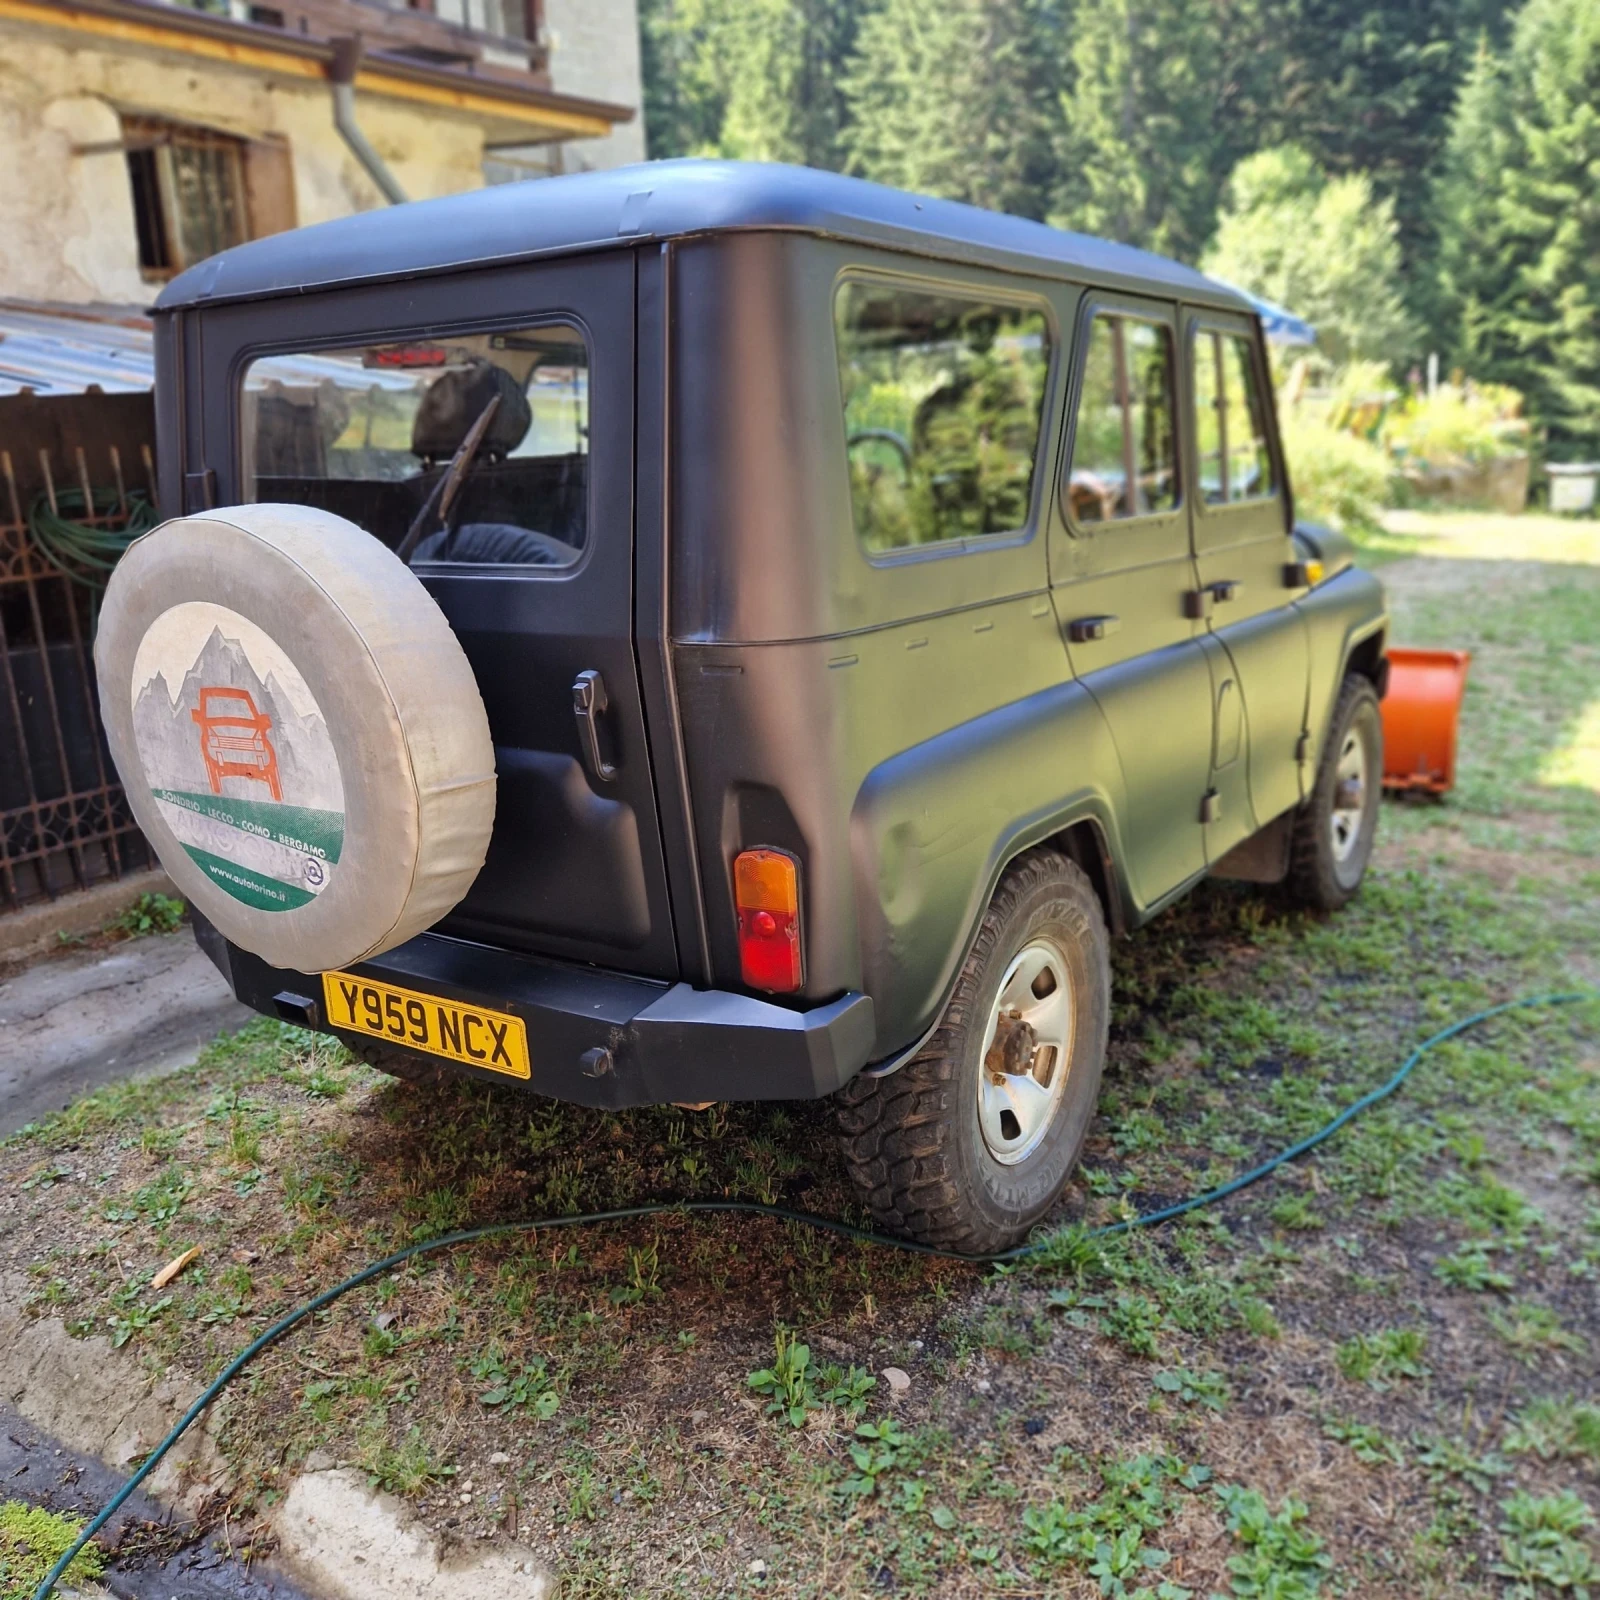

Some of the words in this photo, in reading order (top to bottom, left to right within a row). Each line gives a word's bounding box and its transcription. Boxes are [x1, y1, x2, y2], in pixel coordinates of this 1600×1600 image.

[161, 790, 200, 812] SONDRIO
[207, 807, 234, 824] LECCO
[241, 820, 271, 839] COMO
[279, 833, 326, 859] BERGAMO
[209, 865, 286, 902] www.autotorino.it
[340, 981, 429, 1044] Y959
[438, 1007, 513, 1067] NCX
